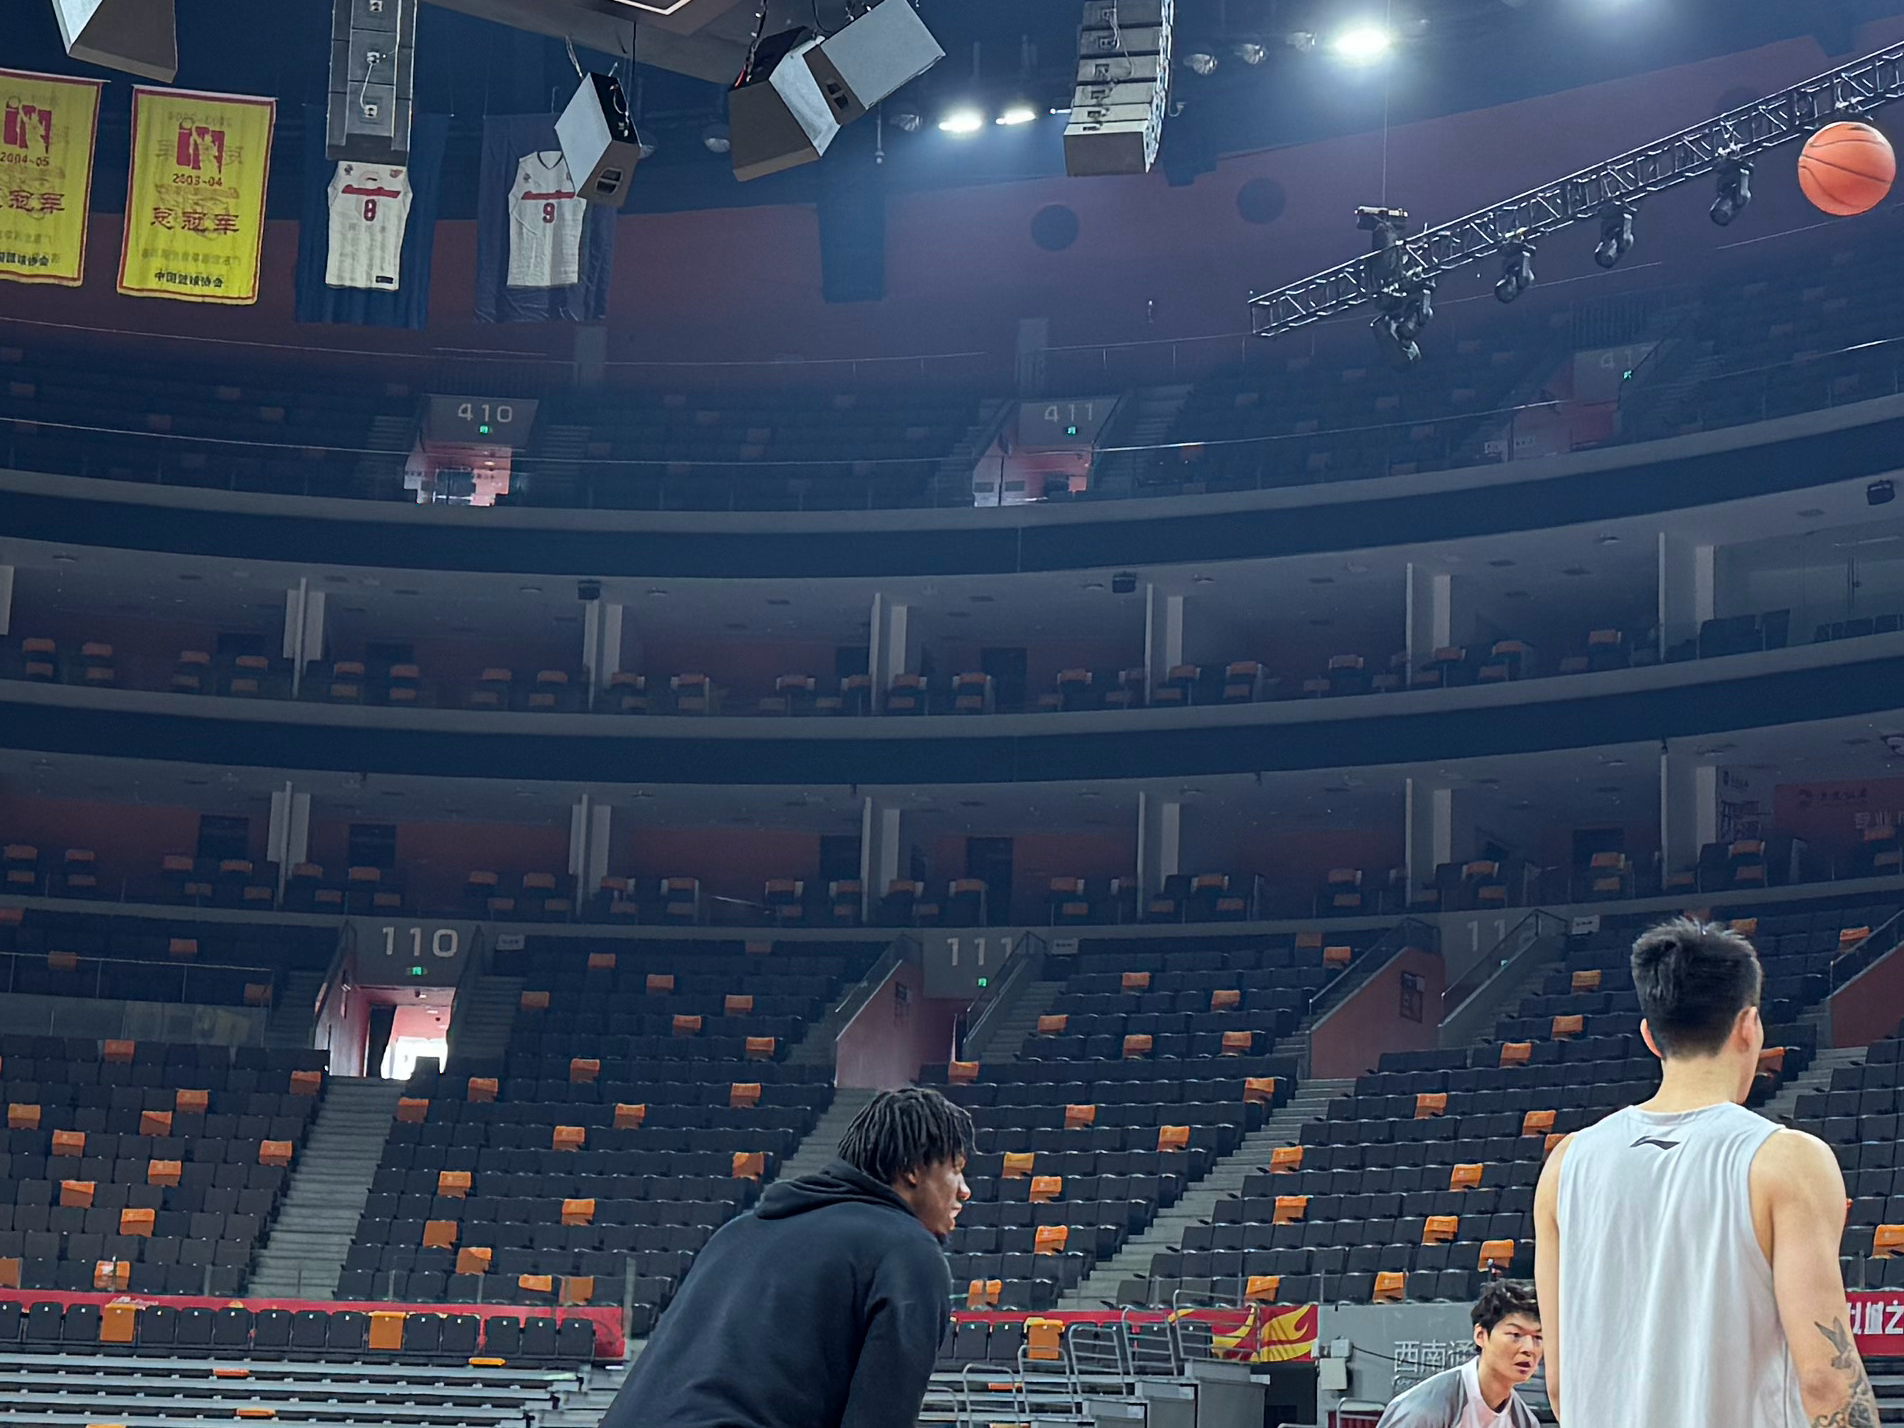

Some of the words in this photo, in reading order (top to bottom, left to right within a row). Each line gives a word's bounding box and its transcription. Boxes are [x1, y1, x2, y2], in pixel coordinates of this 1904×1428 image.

[151, 206, 240, 235] 总冠军
[363, 198, 377, 222] 8
[542, 202, 555, 224] 9
[457, 401, 514, 424] 410
[1043, 402, 1094, 425] 411
[381, 926, 458, 958] 110
[947, 937, 1013, 964] 111
